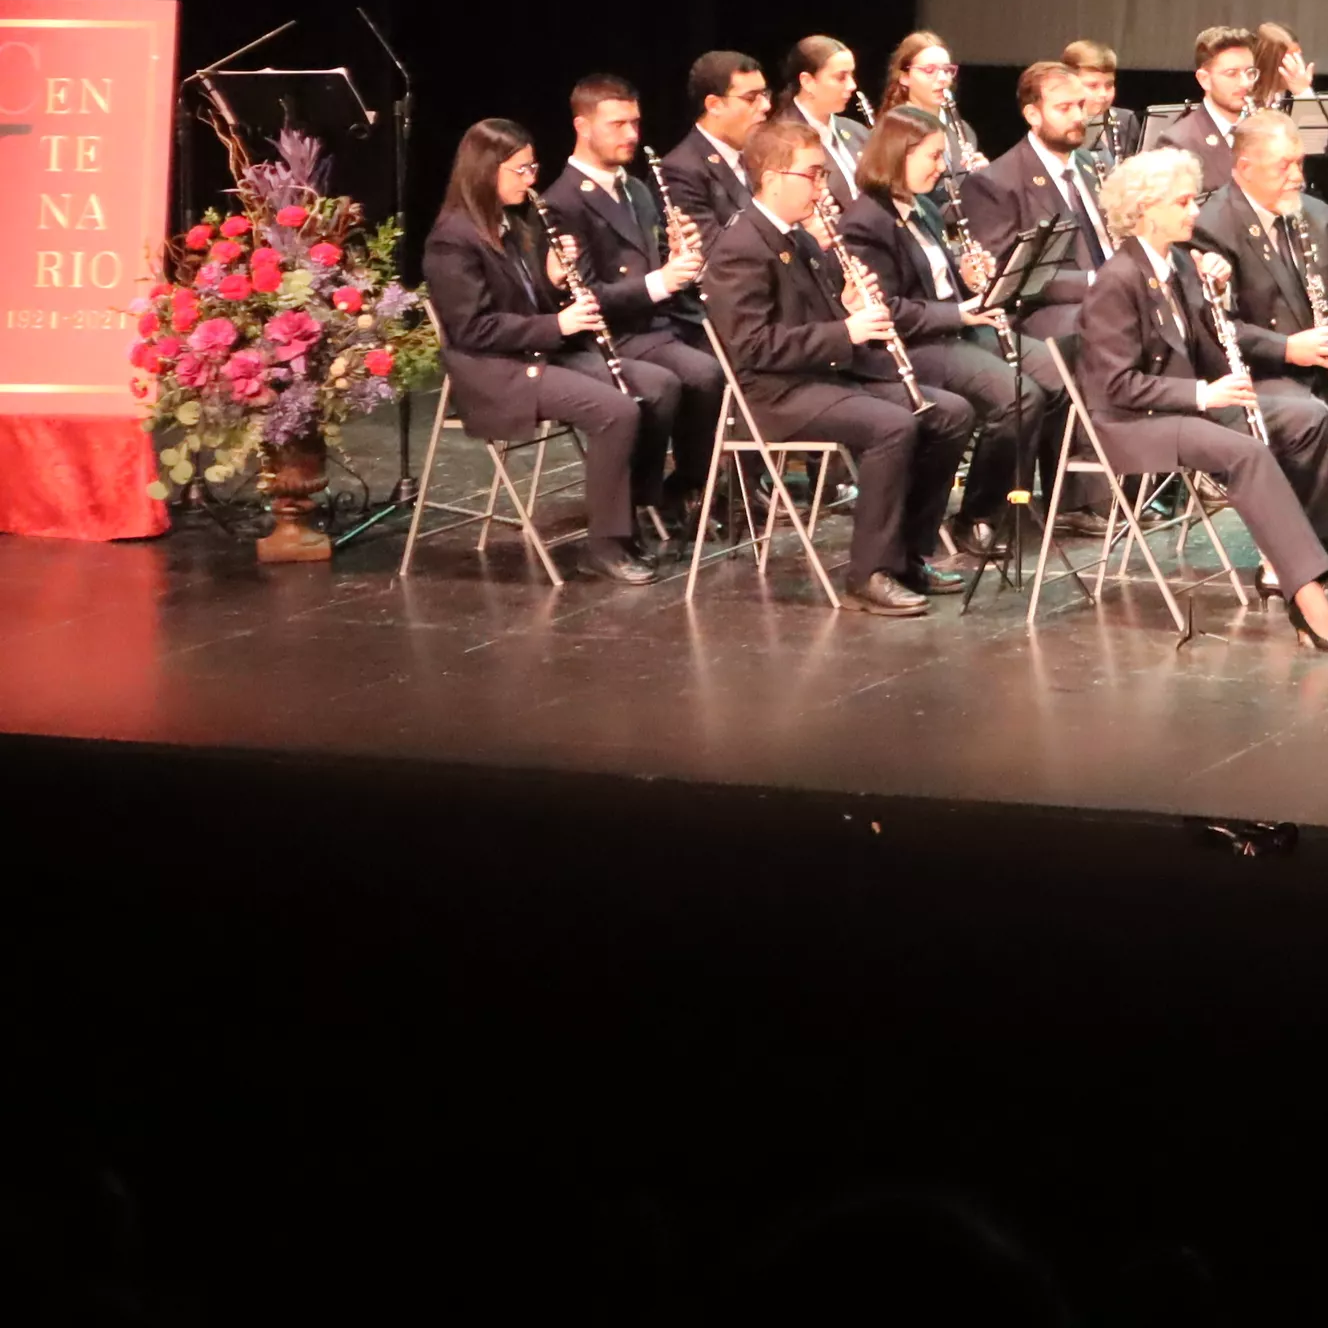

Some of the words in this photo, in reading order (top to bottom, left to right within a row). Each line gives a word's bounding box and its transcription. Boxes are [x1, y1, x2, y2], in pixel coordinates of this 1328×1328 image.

[40, 135, 101, 172] TE
[37, 193, 108, 230] NA
[33, 251, 122, 289] RIO
